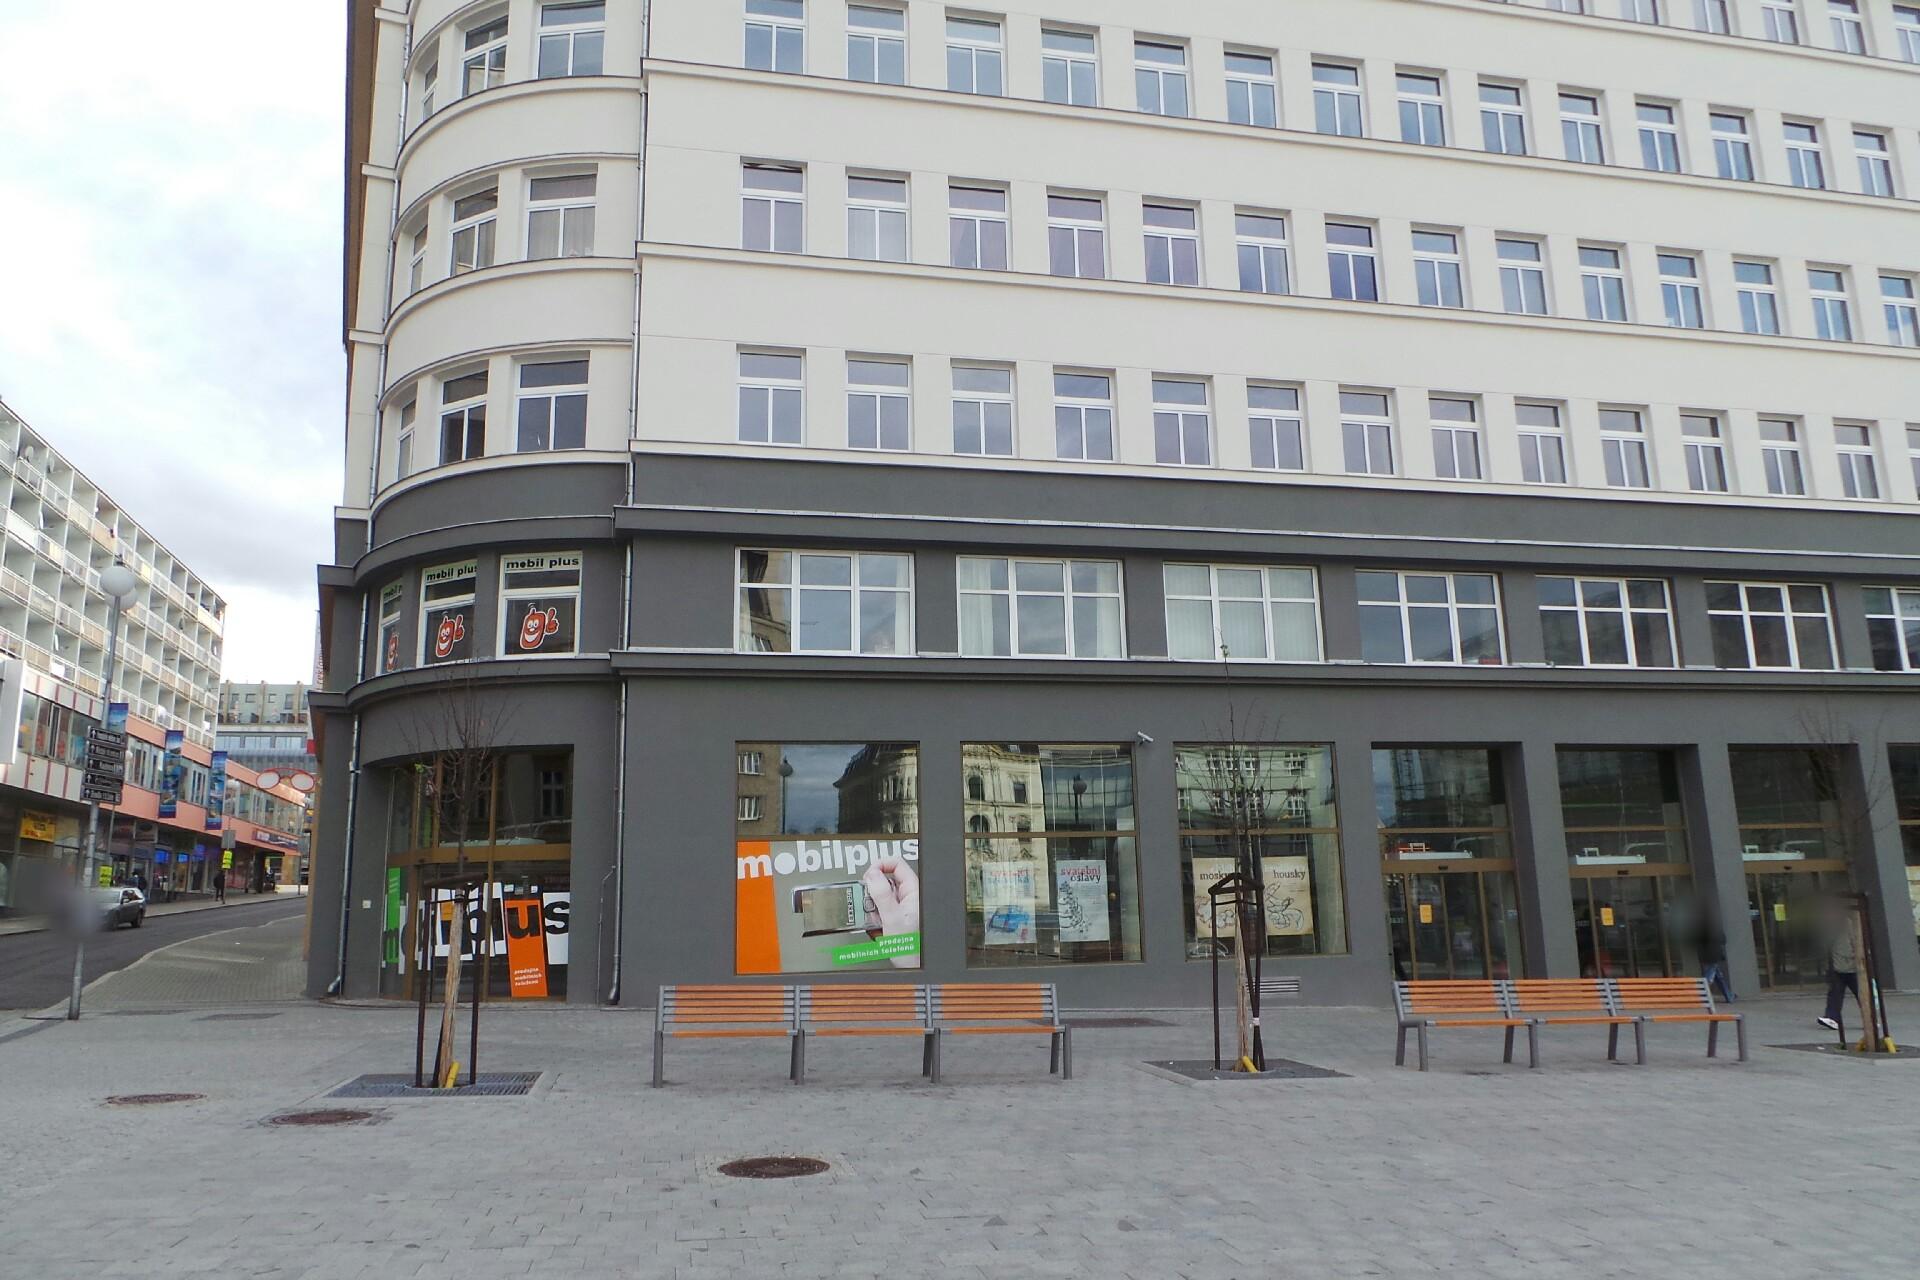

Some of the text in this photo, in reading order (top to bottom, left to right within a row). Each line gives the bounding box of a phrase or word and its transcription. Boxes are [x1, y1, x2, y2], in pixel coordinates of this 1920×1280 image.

[506, 557, 579, 569] mobil plus
[426, 567, 454, 581] mobil
[737, 839, 919, 880] mobilplus
[1060, 865, 1101, 876] svatební
[1273, 868, 1306, 881] housky
[1070, 873, 1101, 884] oslavy
[879, 936, 914, 947] prodejna
